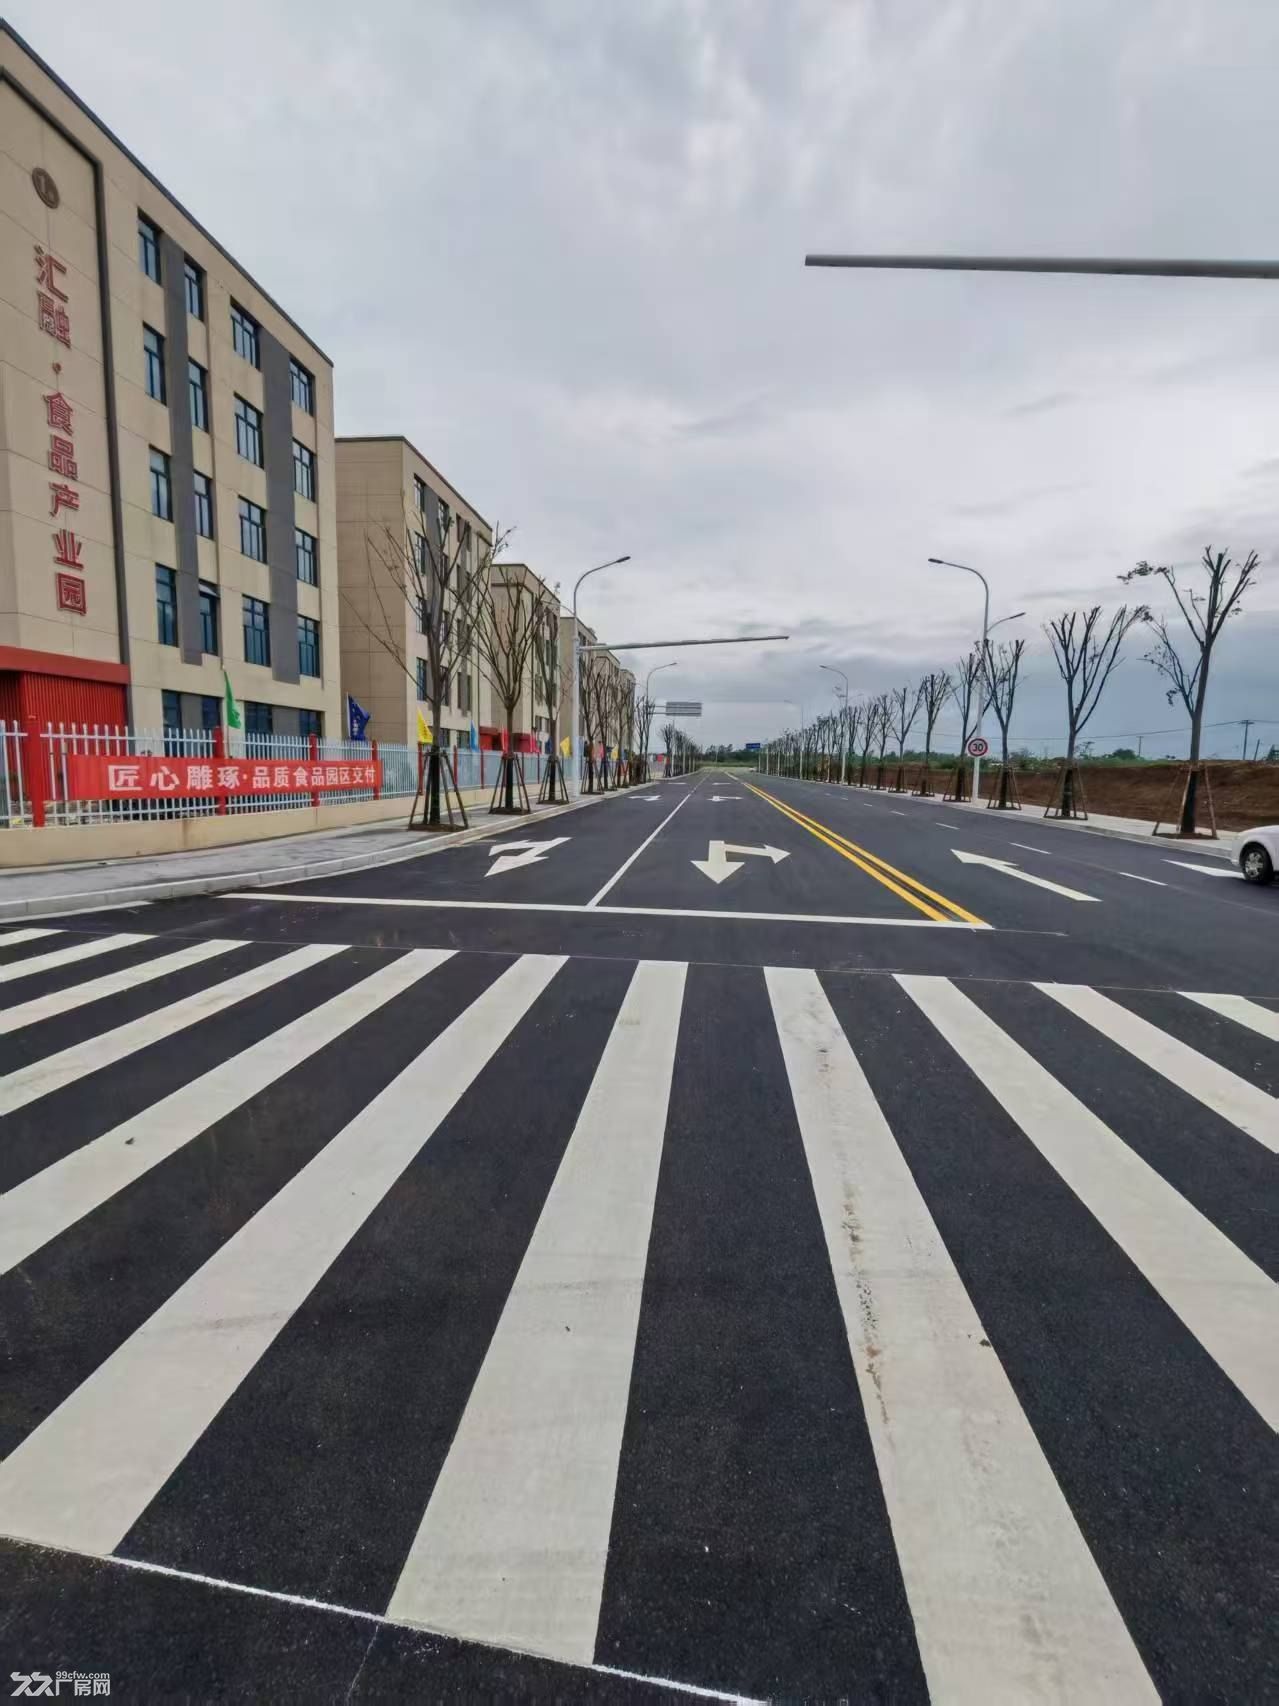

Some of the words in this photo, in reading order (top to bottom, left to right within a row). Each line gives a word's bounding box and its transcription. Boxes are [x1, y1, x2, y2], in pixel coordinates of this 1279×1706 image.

[973, 743, 984, 752] 30
[107, 764, 376, 791] 匠心雕琢·品质食品园区交付
